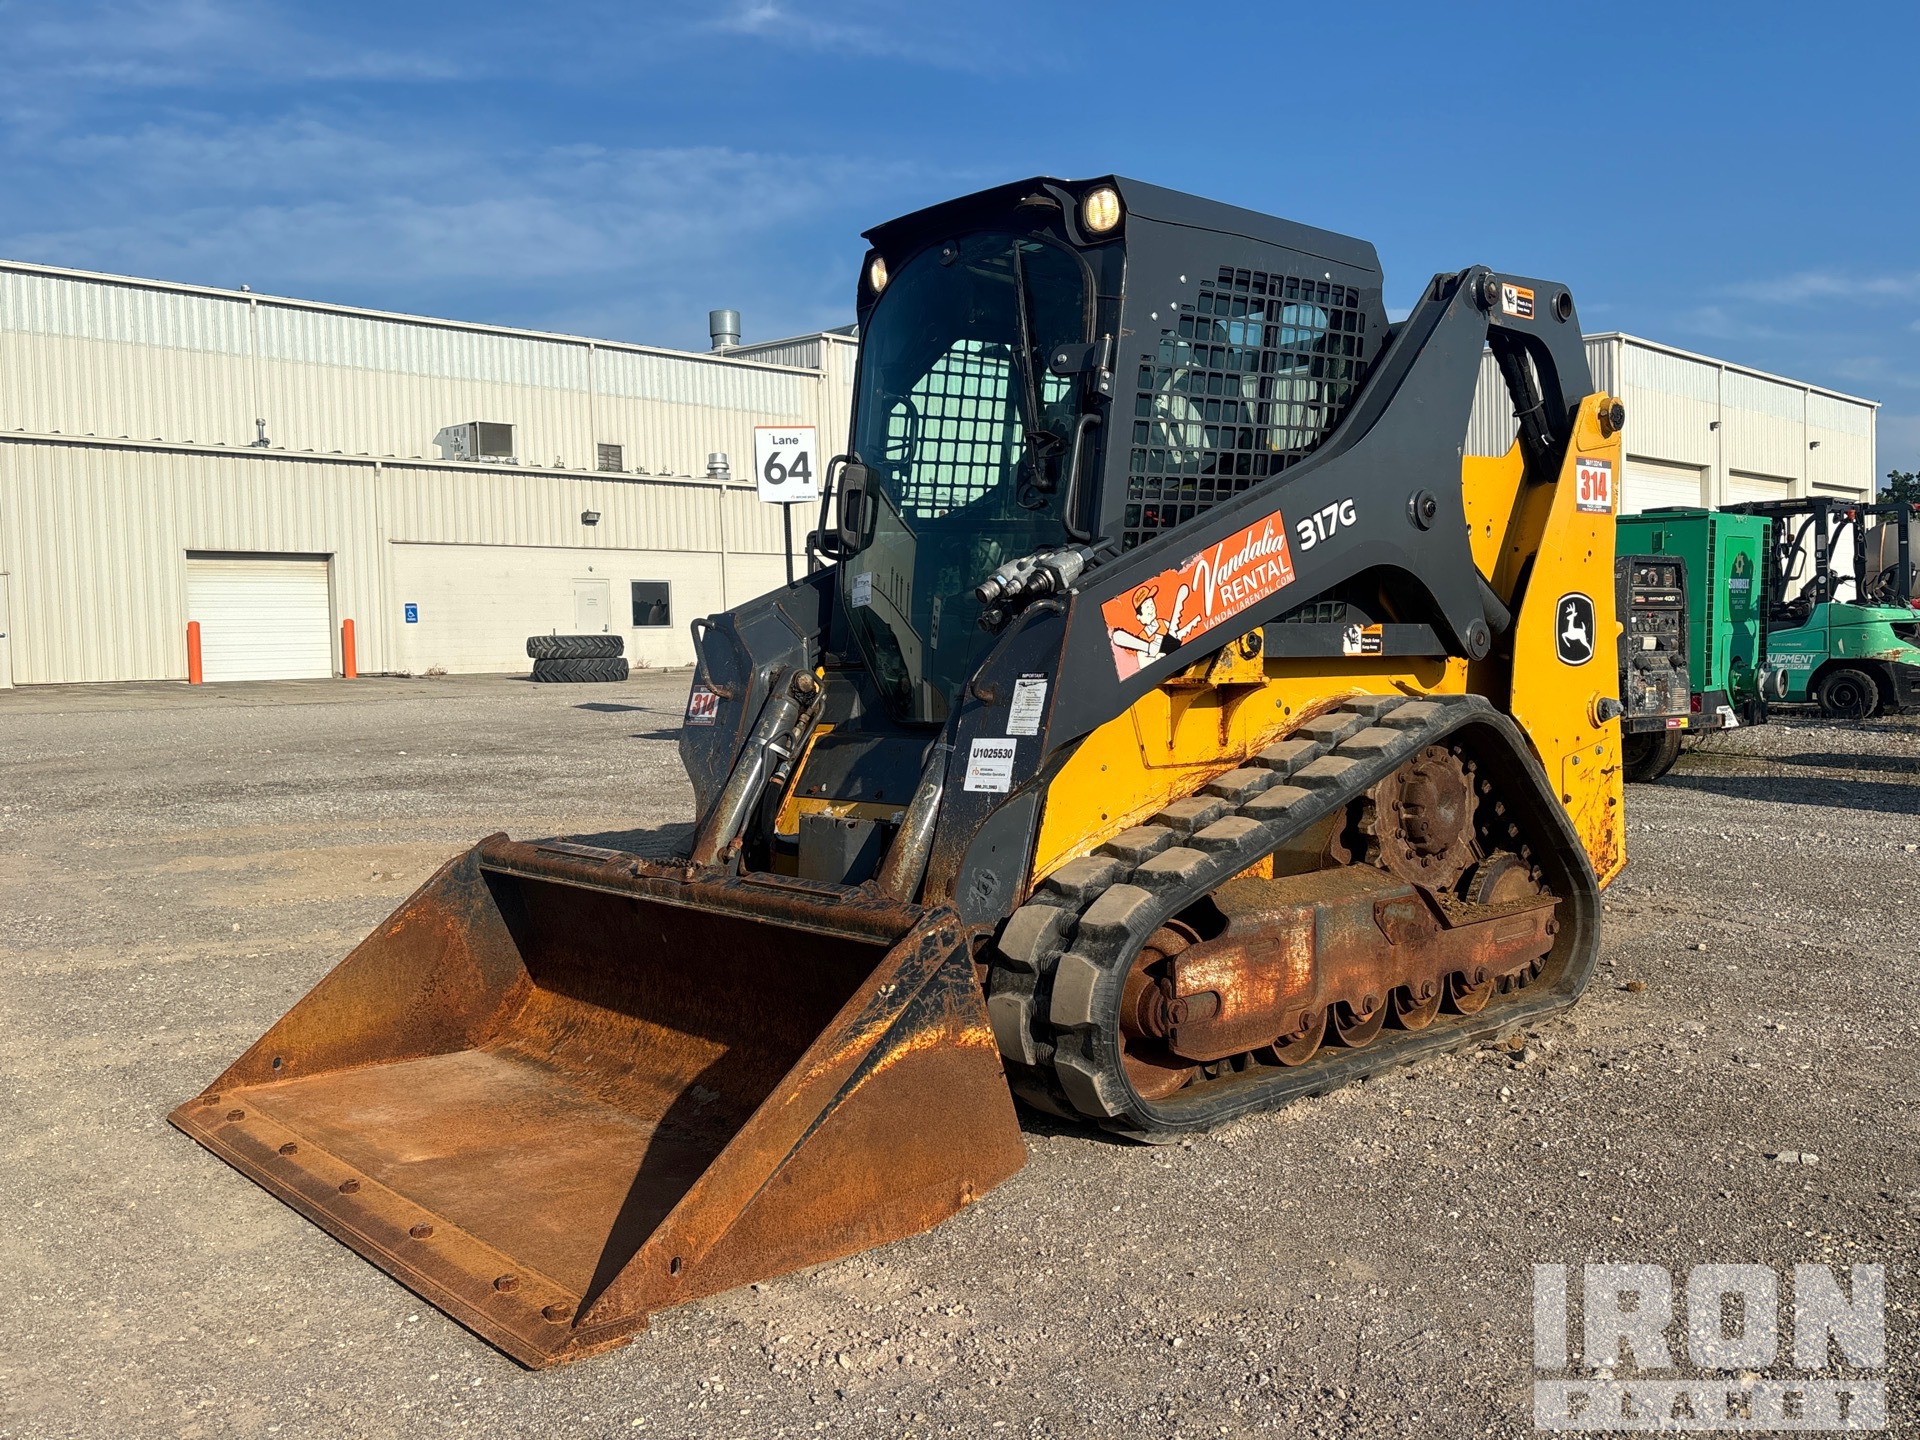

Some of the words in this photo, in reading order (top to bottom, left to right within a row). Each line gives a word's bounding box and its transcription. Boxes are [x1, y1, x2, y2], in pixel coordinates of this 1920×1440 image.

[772, 435, 799, 445] Lane
[764, 451, 812, 485] 64
[1581, 469, 1607, 501] 314
[1296, 498, 1357, 551] 317G
[1192, 519, 1284, 617] Vandalia
[1220, 555, 1290, 607] RENTAL
[1203, 573, 1294, 630] VANDALIARENTAL.COM
[692, 694, 716, 715] 314
[972, 747, 1013, 759] U1025530
